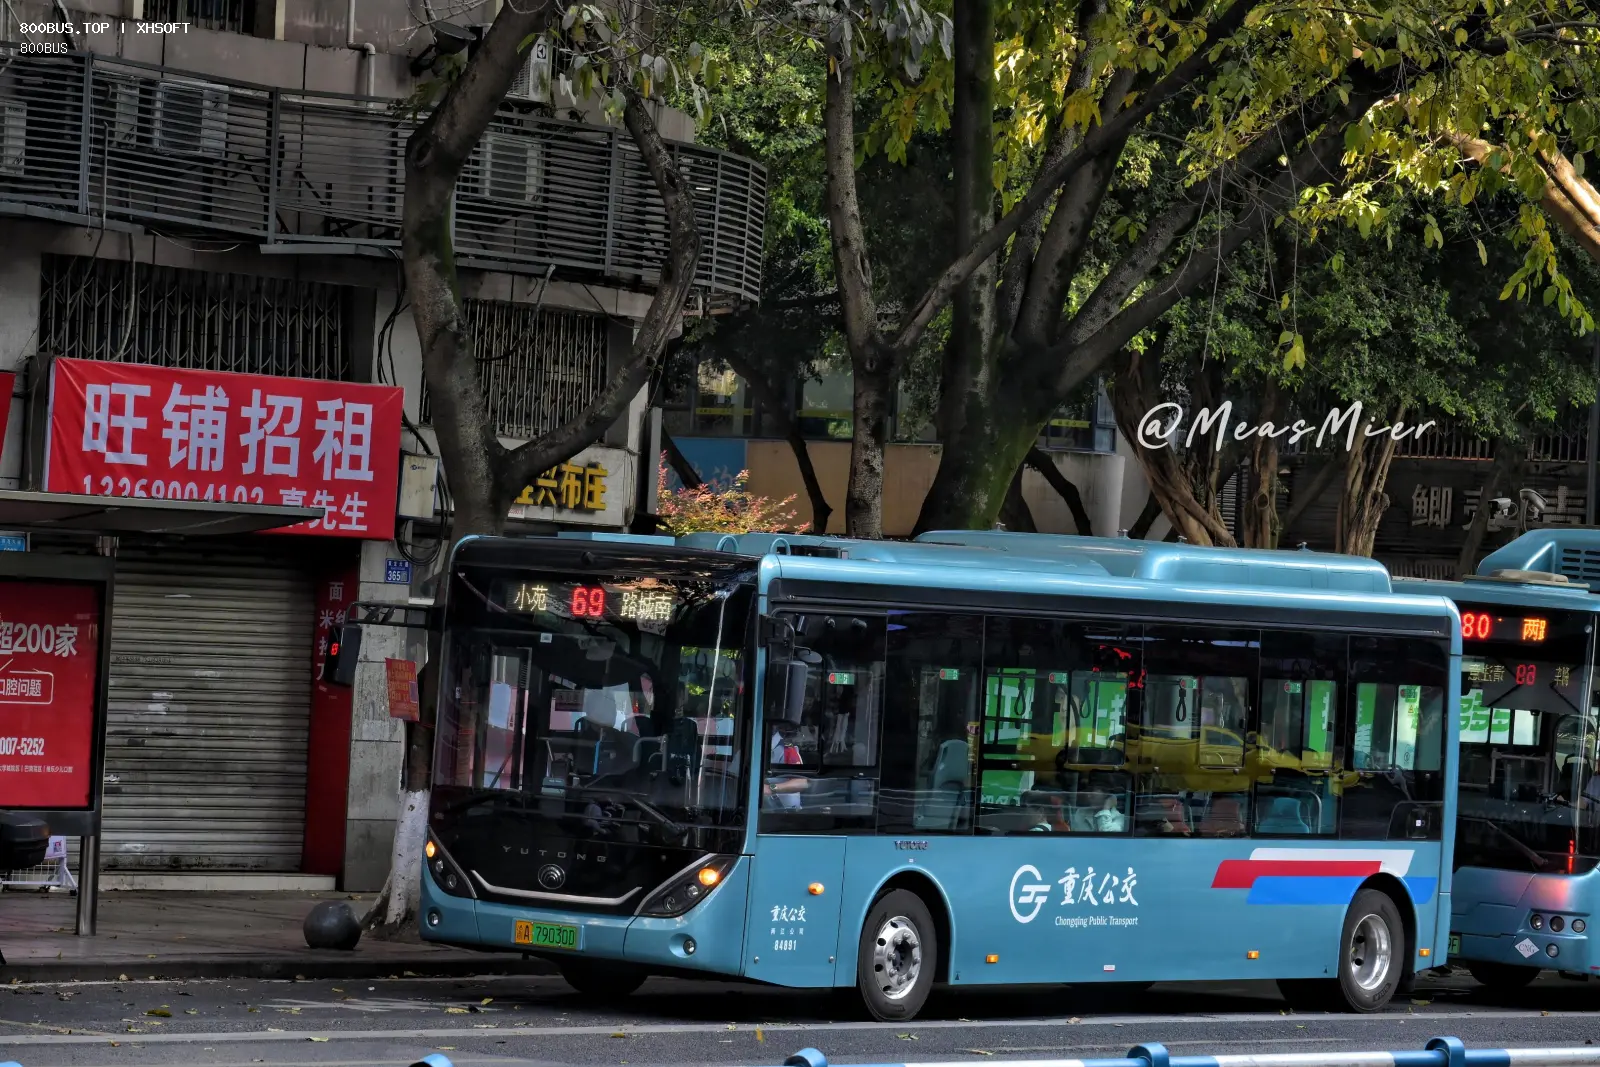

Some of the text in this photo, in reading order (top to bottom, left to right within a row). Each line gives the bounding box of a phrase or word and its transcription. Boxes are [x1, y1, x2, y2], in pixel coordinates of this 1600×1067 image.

[82, 382, 374, 482] 旺铺招租
[513, 583, 549, 612] 小苑
[571, 586, 605, 617] 69
[503, 845, 607, 863] YUTONG
[1058, 866, 1138, 906] 重庆公交
[770, 905, 807, 922] 重庆公交
[1055, 916, 1138, 928] Chongqing Public Transport
[1518, 943, 1535, 954] CNG
